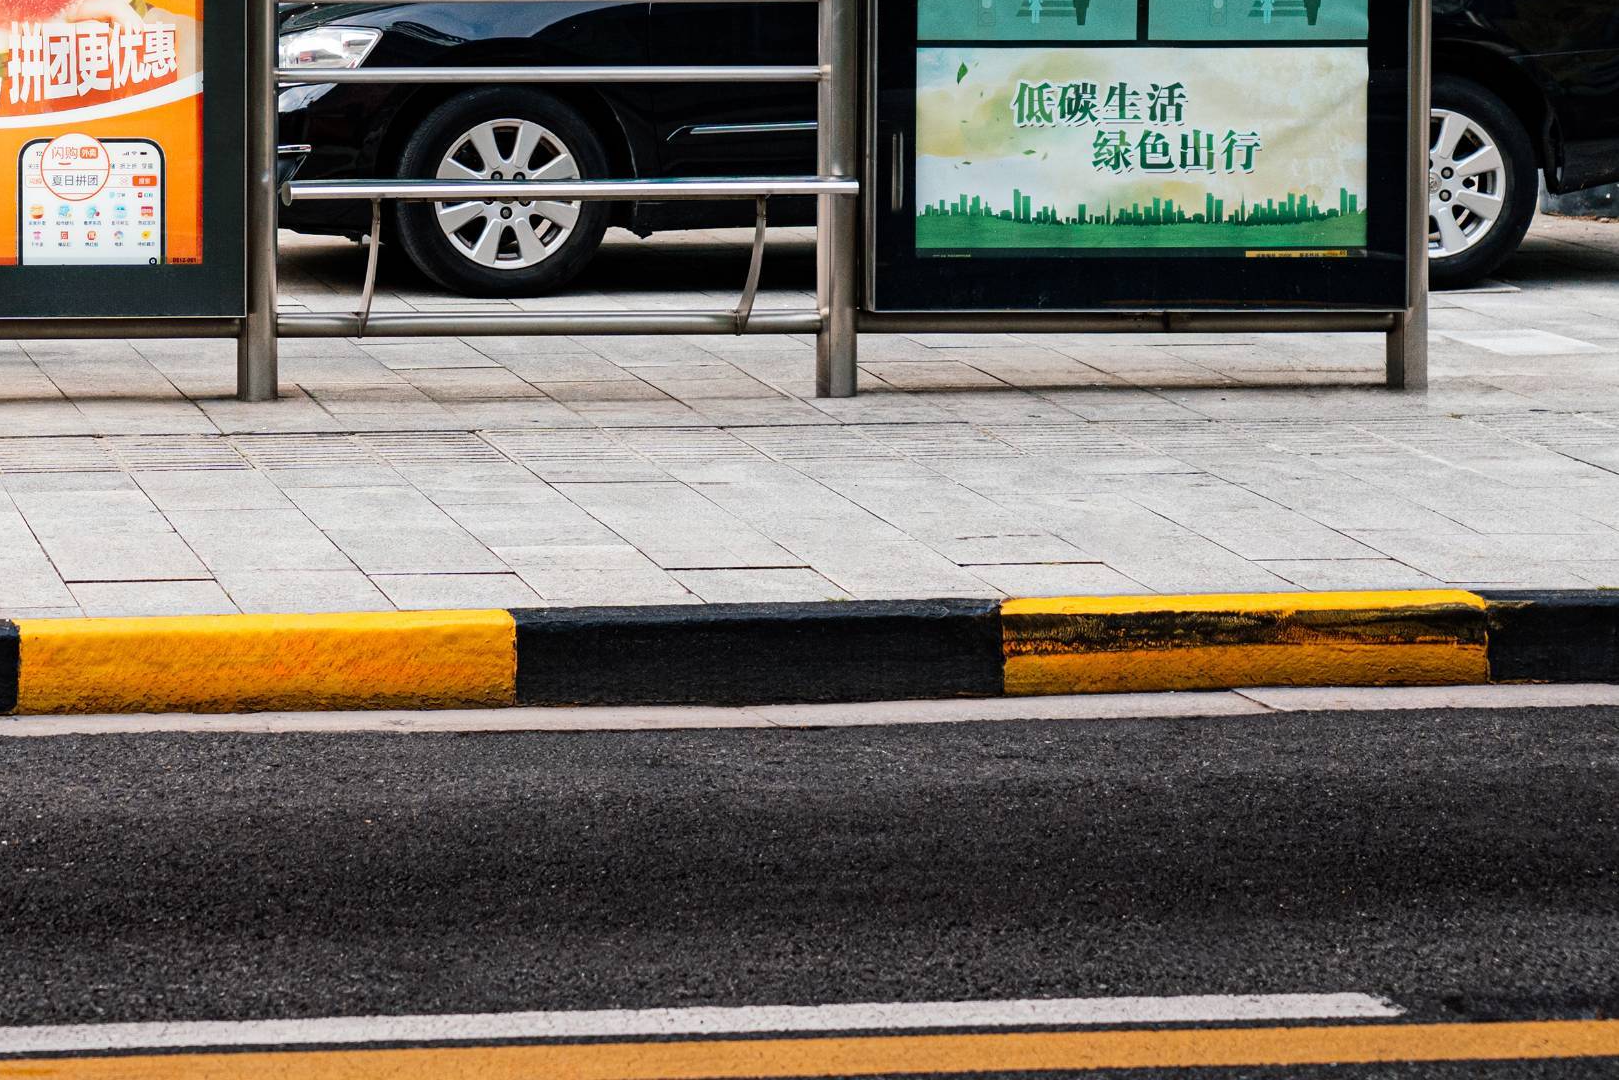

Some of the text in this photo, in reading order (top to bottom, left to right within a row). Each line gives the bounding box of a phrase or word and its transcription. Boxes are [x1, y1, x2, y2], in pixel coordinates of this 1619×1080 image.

[1013, 82, 1188, 125] 低碳生活
[52, 146, 78, 160] 闪购
[1092, 128, 1261, 172] 绿色出行
[52, 174, 98, 187] 夏日拼团
